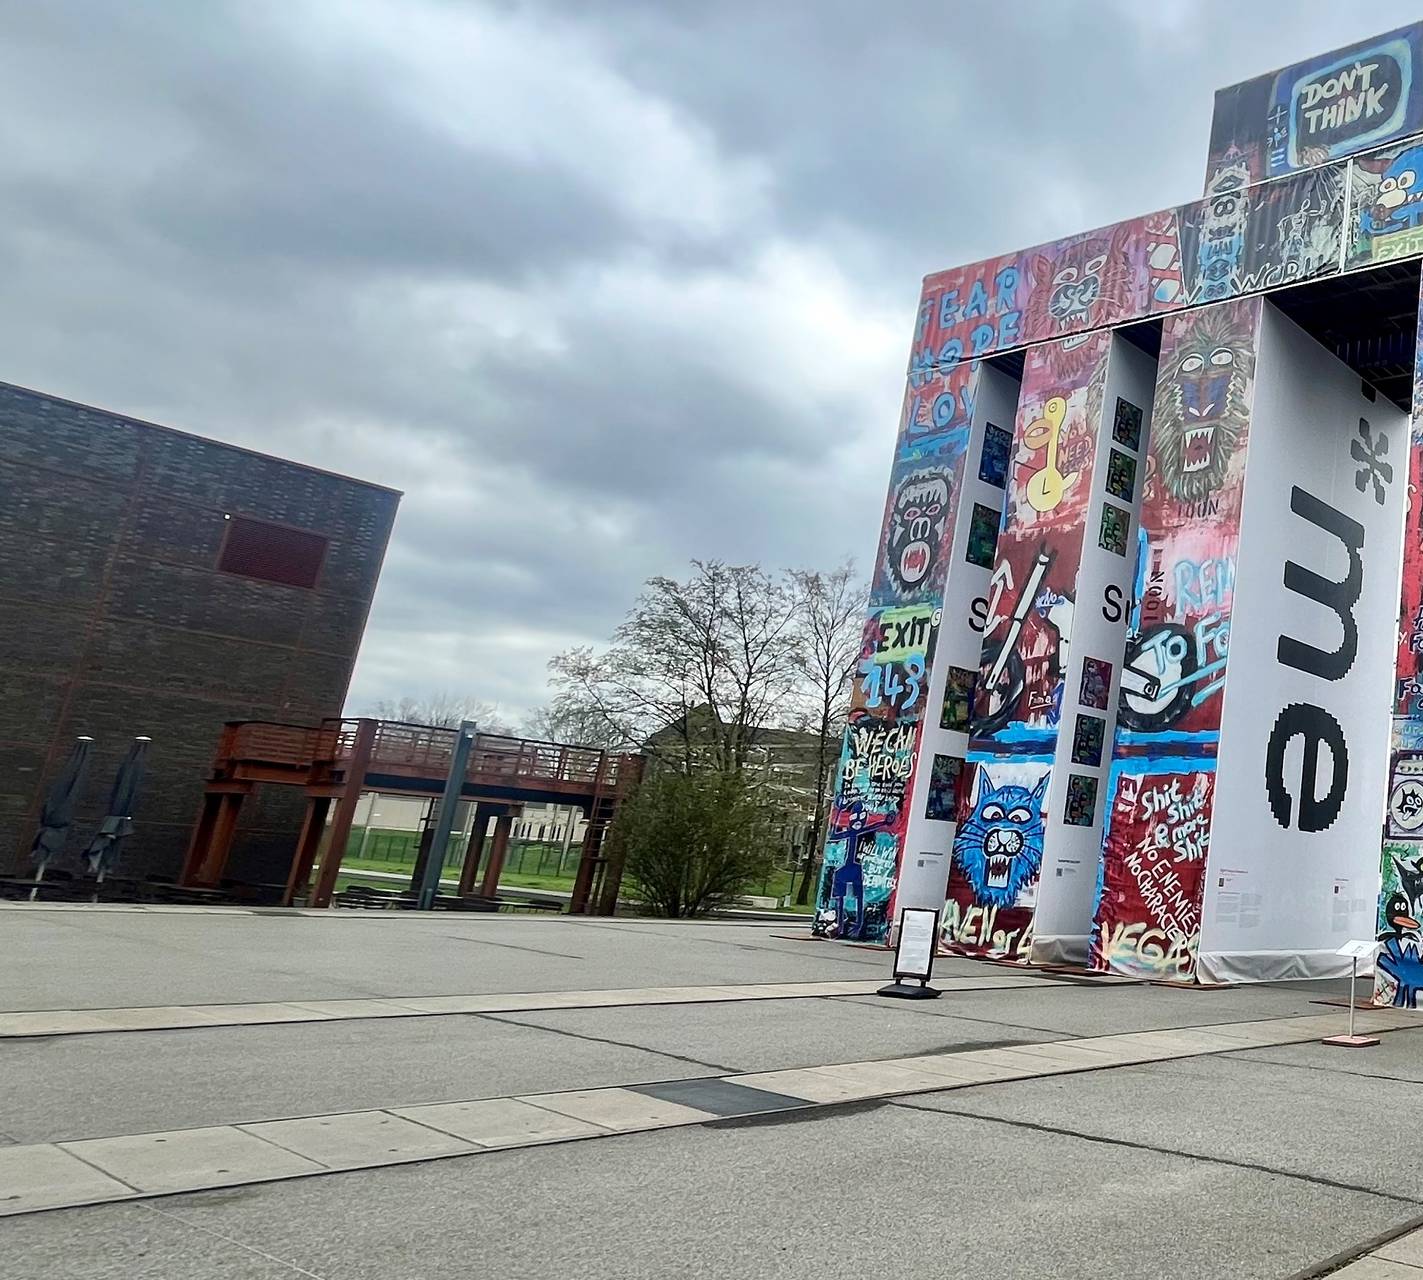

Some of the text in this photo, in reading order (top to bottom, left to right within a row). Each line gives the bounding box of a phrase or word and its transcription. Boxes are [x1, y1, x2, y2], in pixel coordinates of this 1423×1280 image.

[1301, 61, 1380, 110] DON'T
[914, 265, 1019, 343] FEAR
[910, 310, 1023, 389] HOPE
[876, 616, 931, 653] EXIT
[1141, 630, 1188, 674] TO
[885, 725, 918, 754] CAN
[843, 751, 918, 781] BE HEROES
[1140, 778, 1183, 822] Shit
[1172, 813, 1210, 843] more
[1173, 828, 1211, 864] Shit
